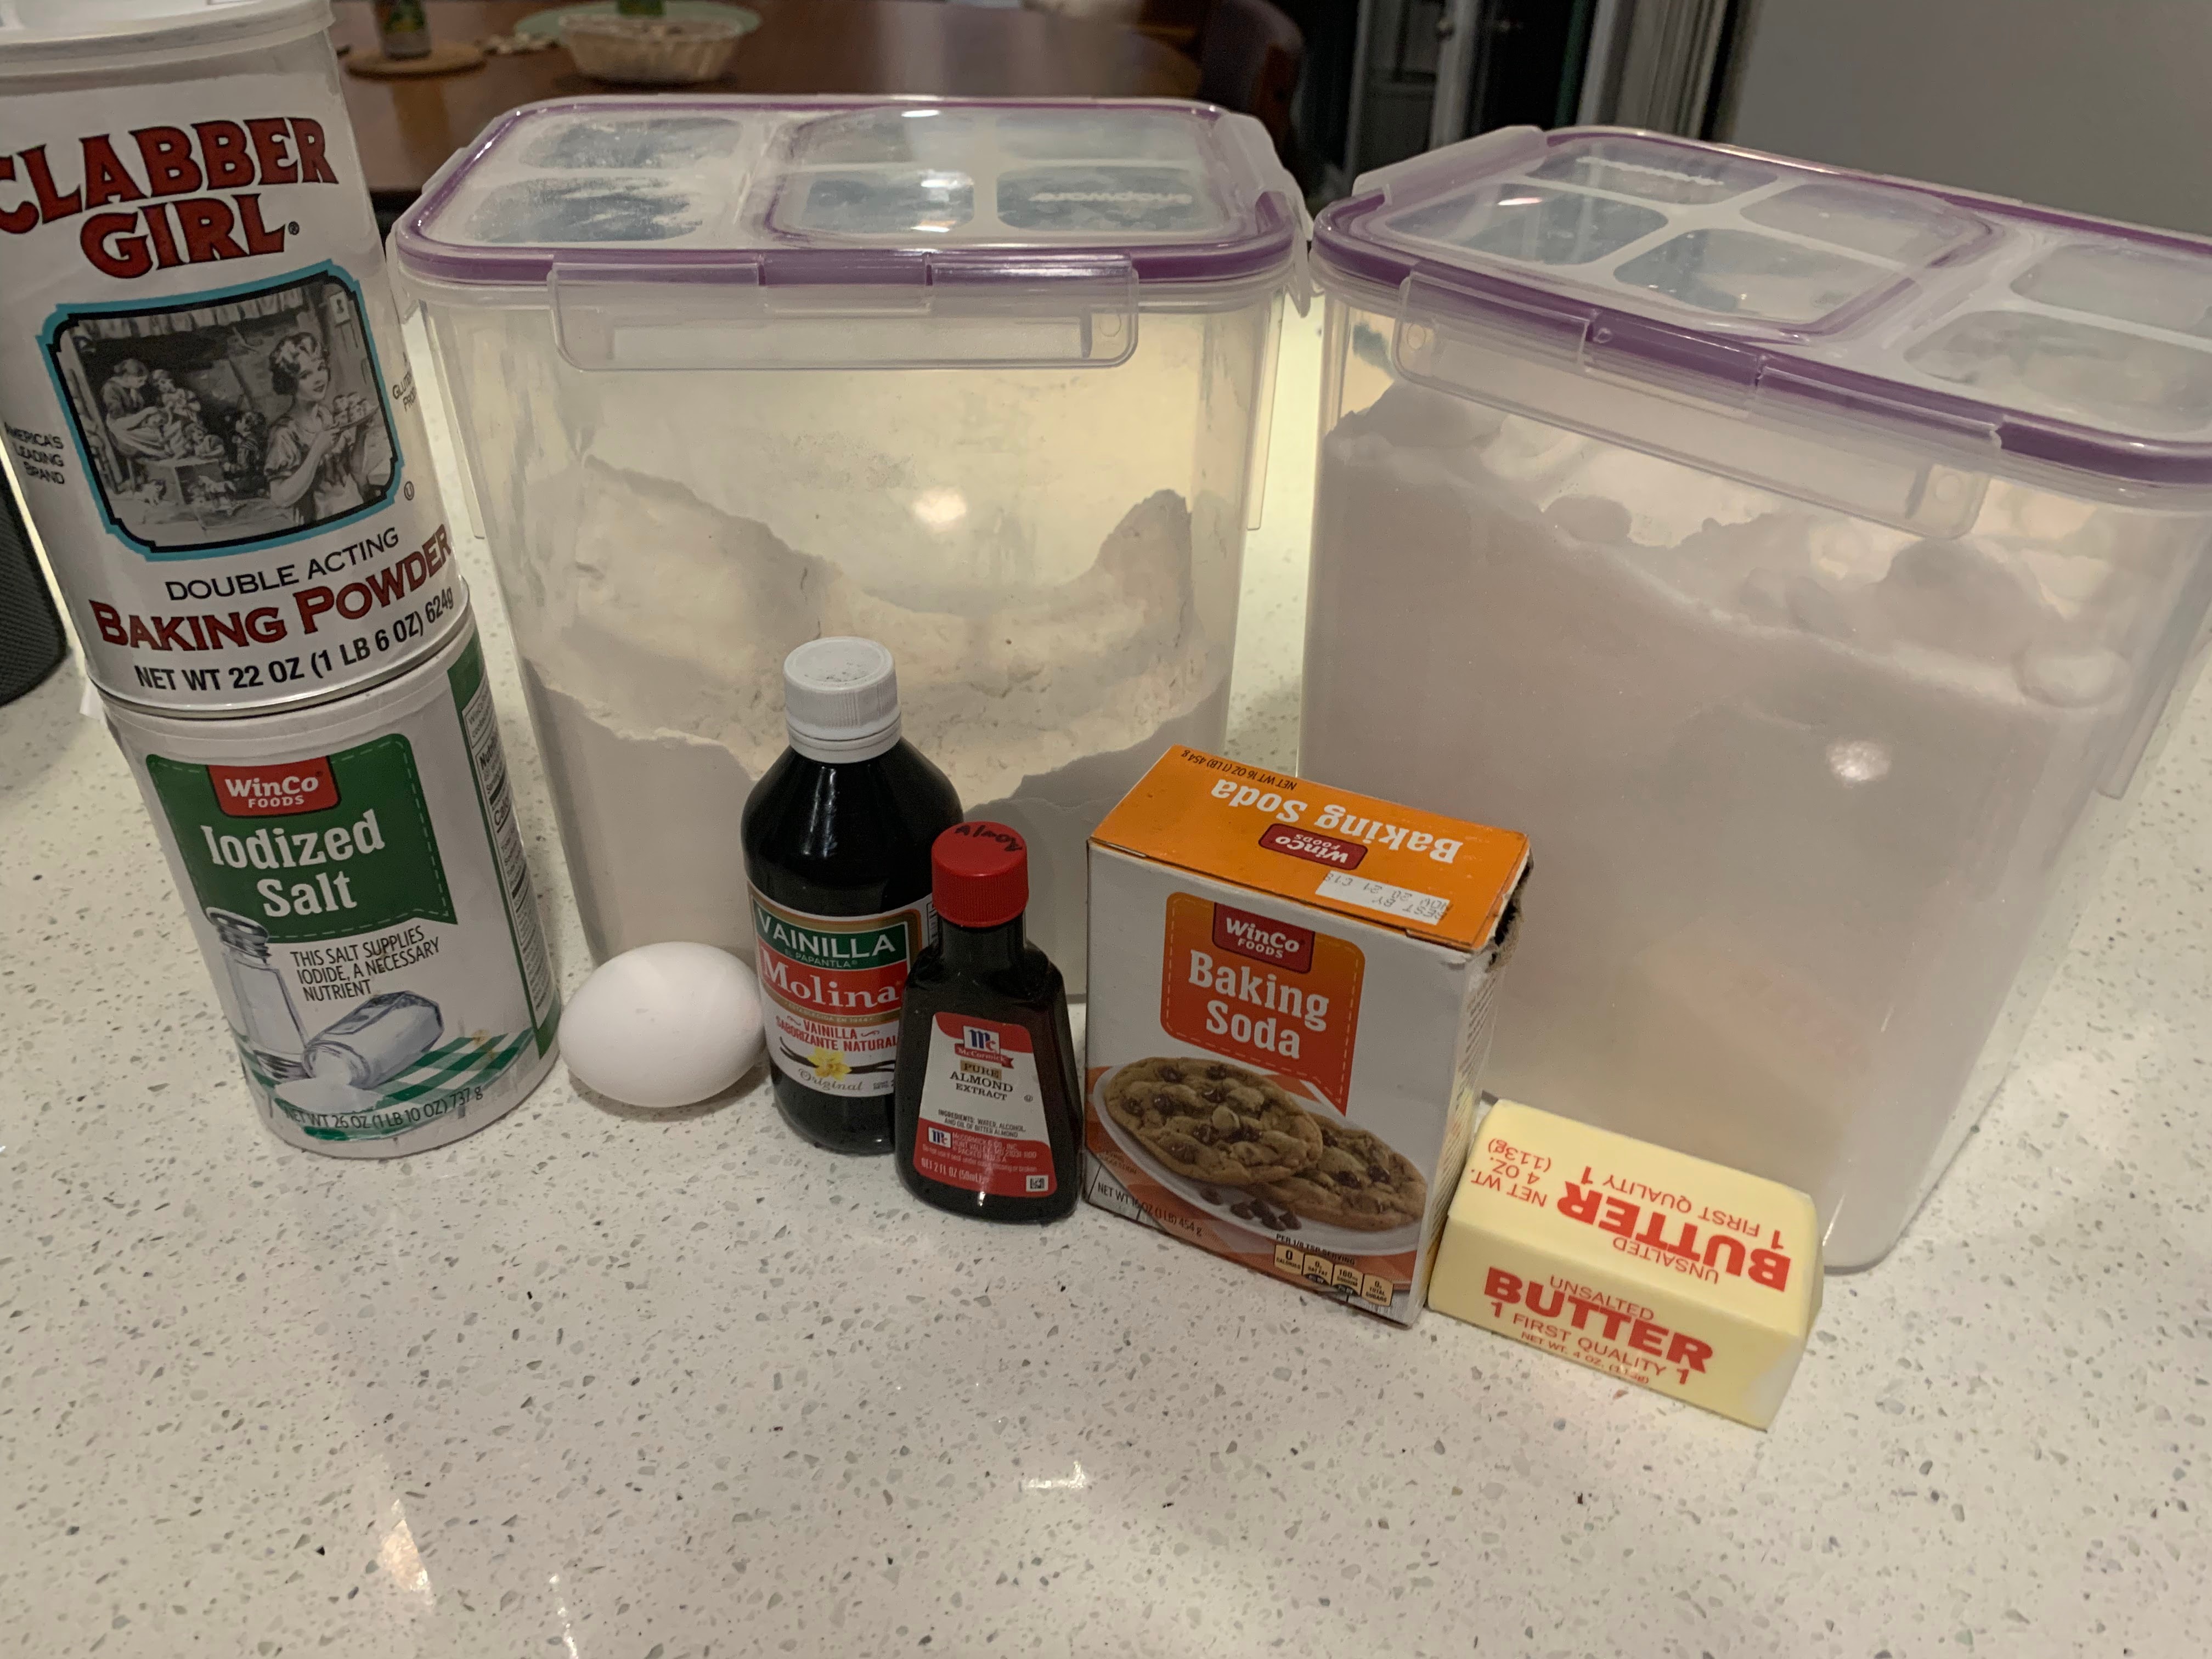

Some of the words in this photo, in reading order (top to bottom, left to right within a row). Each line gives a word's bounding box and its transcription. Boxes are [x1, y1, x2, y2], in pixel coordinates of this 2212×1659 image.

[0, 117, 339, 234] CLABBER
[80, 193, 286, 279] GIRL
[165, 565, 300, 601] DOUBLE
[308, 527, 399, 580] ACTING
[88, 600, 288, 651] BAKING
[292, 523, 452, 635] POWDER
[134, 665, 176, 690] NET
[182, 669, 221, 690] WT
[228, 665, 263, 689] 22
[268, 657, 304, 683] OZ
[311, 650, 332, 679] (1
[340, 637, 371, 666] LB
[375, 629, 390, 652] 6
[393, 611, 424, 637] OZ)
[425, 586, 454, 623] 624g
[1187, 753, 1206, 764] 454
[1206, 758, 1222, 769] LB)
[1231, 766, 1247, 776] OZ
[225, 776, 319, 797] WinCo
[1248, 771, 1258, 780] 16
[1258, 774, 1276, 785] WT
[1277, 778, 1297, 790] NET
[249, 795, 304, 808] FOODS
[1211, 778, 1308, 823] Soda
[200, 808, 385, 870] Iodized
[1294, 834, 1340, 850] FOODS
[1314, 804, 1464, 864] Baking
[1275, 836, 1348, 863] WinCo
[257, 871, 357, 917] Salt
[290, 950, 324, 967] THIS
[325, 944, 359, 964] SALT
[362, 925, 425, 958] SUPPLIES
[758, 908, 896, 958] VAINILLA
[1226, 917, 1300, 952] WinCo
[296, 966, 350, 984] IODIDE,
[354, 963, 364, 979] A
[364, 936, 439, 975] NECESSARY
[1238, 938, 1284, 958] FOODS
[302, 979, 371, 1001] NUTRIENT
[760, 945, 900, 1008] Molina
[1188, 949, 1329, 1032] Baking
[803, 1020, 857, 1040] VAINILLA
[844, 1035, 897, 1052] NATURAL
[1206, 1000, 1300, 1060] Soda
[957, 1047, 1006, 1063] McCormick
[798, 1068, 863, 1091] Original
[950, 1071, 1013, 1092] ALMOND
[964, 1062, 1000, 1079] PURE
[956, 1083, 1007, 1101] EXTRACT
[285, 1106, 306, 1124] NET
[307, 1114, 328, 1127] WT
[331, 1115, 349, 1128] 26
[351, 1115, 370, 1128] OZ
[386, 1112, 403, 1126] LB
[404, 1107, 421, 1124] 10
[423, 1099, 448, 1118] OZ)
[450, 1087, 470, 1108] 737
[1488, 1138, 1551, 1172] (113g)
[1490, 1157, 1520, 1178] OZ.
[1470, 1169, 1500, 1191] WT.
[1527, 1171, 1541, 1184] 4
[1581, 1166, 1594, 1185] 1
[1098, 1182, 1114, 1197] NET
[1115, 1189, 1129, 1204] WT
[1180, 1218, 1195, 1231] 454
[1506, 1183, 1547, 1207] NET
[1602, 1175, 1692, 1214] QUALITY
[1698, 1206, 1761, 1238] FIRST
[1277, 1233, 1291, 1245] PER
[1557, 1181, 1791, 1293] BUTTER
[1771, 1229, 1784, 1250] 1
[1285, 1250, 1293, 1261] 0
[1613, 1236, 1719, 1284] UNSALTED
[1550, 1274, 1655, 1321] UNSALTED
[1484, 1267, 1713, 1374] BUTTER
[1491, 1301, 1503, 1318] 1
[1513, 1313, 1571, 1342] FIRST
[1578, 1338, 1667, 1376] QUALITY
[1677, 1369, 1690, 1385] 1
[1521, 1331, 1543, 1345] NET
[1548, 1341, 1567, 1355] WT.
[1585, 1355, 1604, 1368] OZ.
